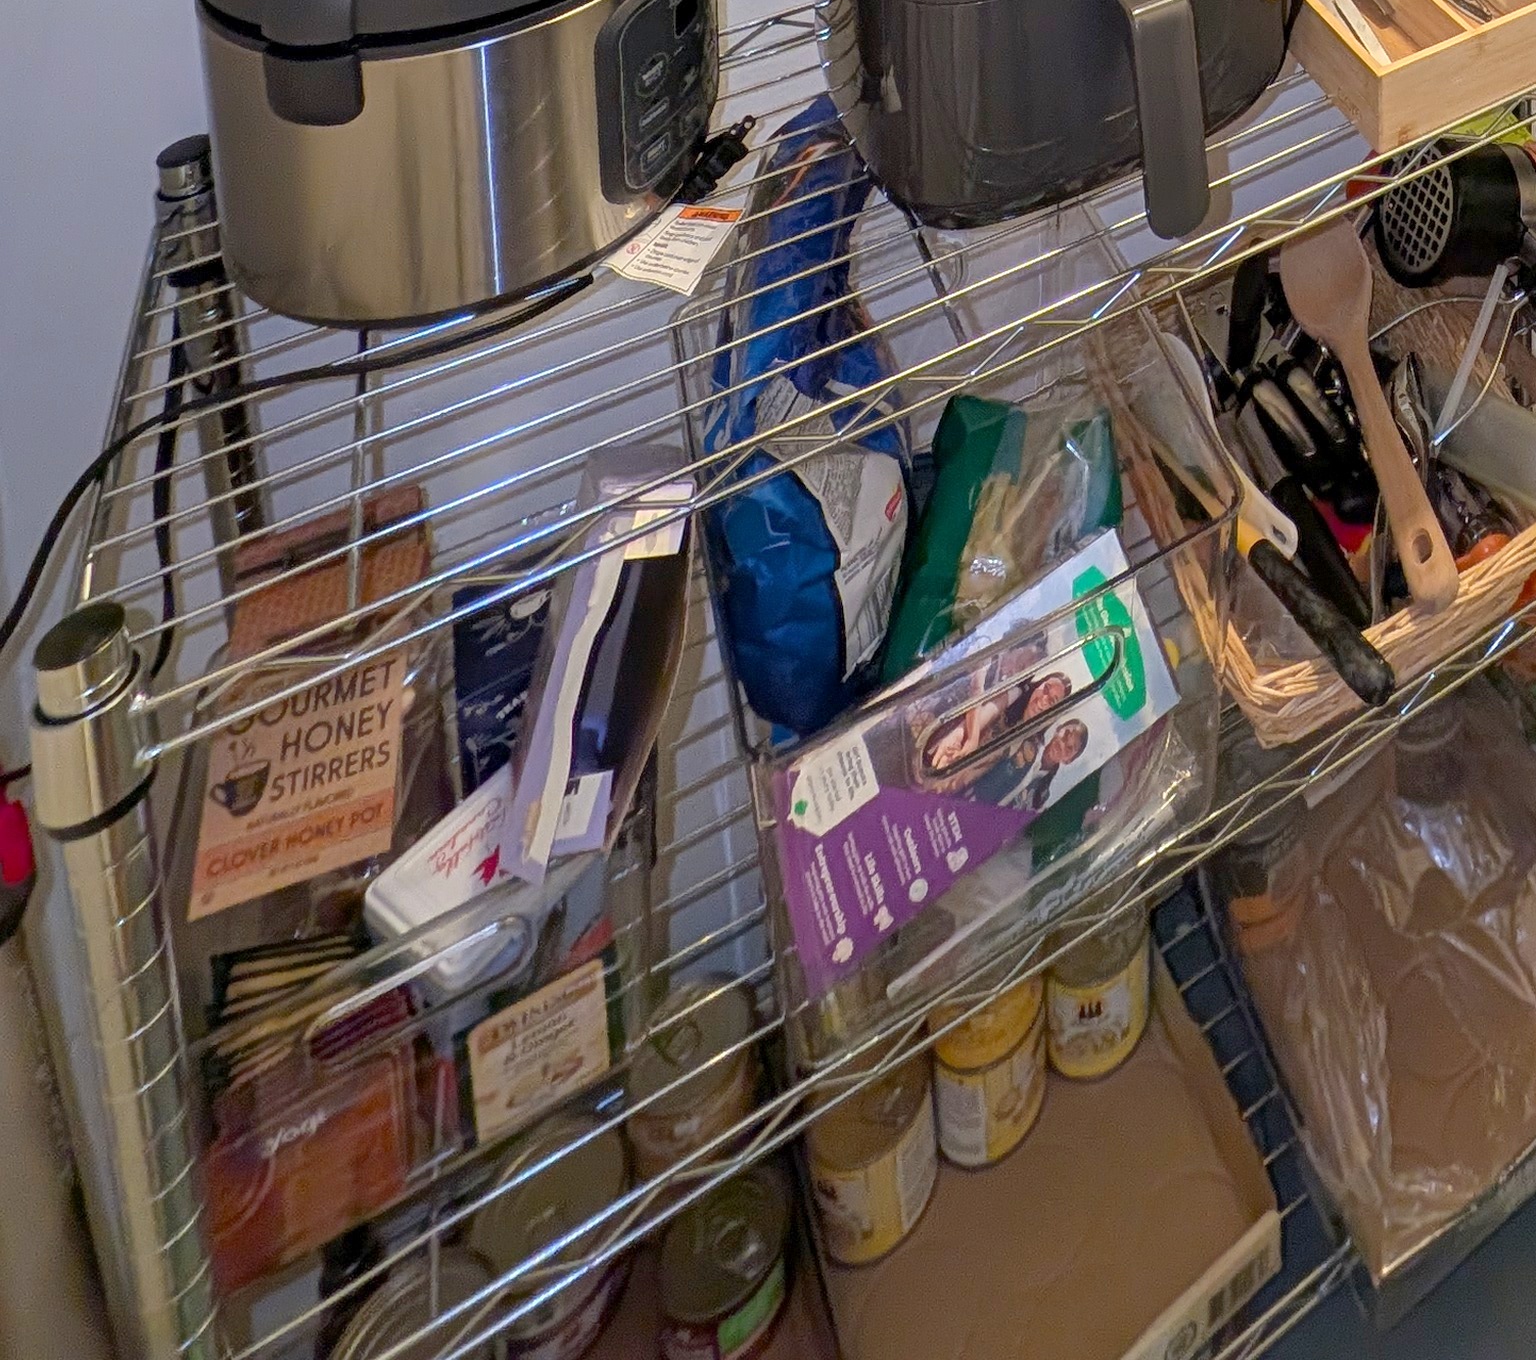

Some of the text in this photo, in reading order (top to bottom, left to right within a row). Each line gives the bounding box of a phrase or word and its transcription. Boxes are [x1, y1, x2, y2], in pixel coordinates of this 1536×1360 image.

[280, 701, 395, 763] HONEY
[267, 742, 392, 804] STIRRERS
[284, 818, 345, 851] HONEY
[346, 804, 385, 833] POT
